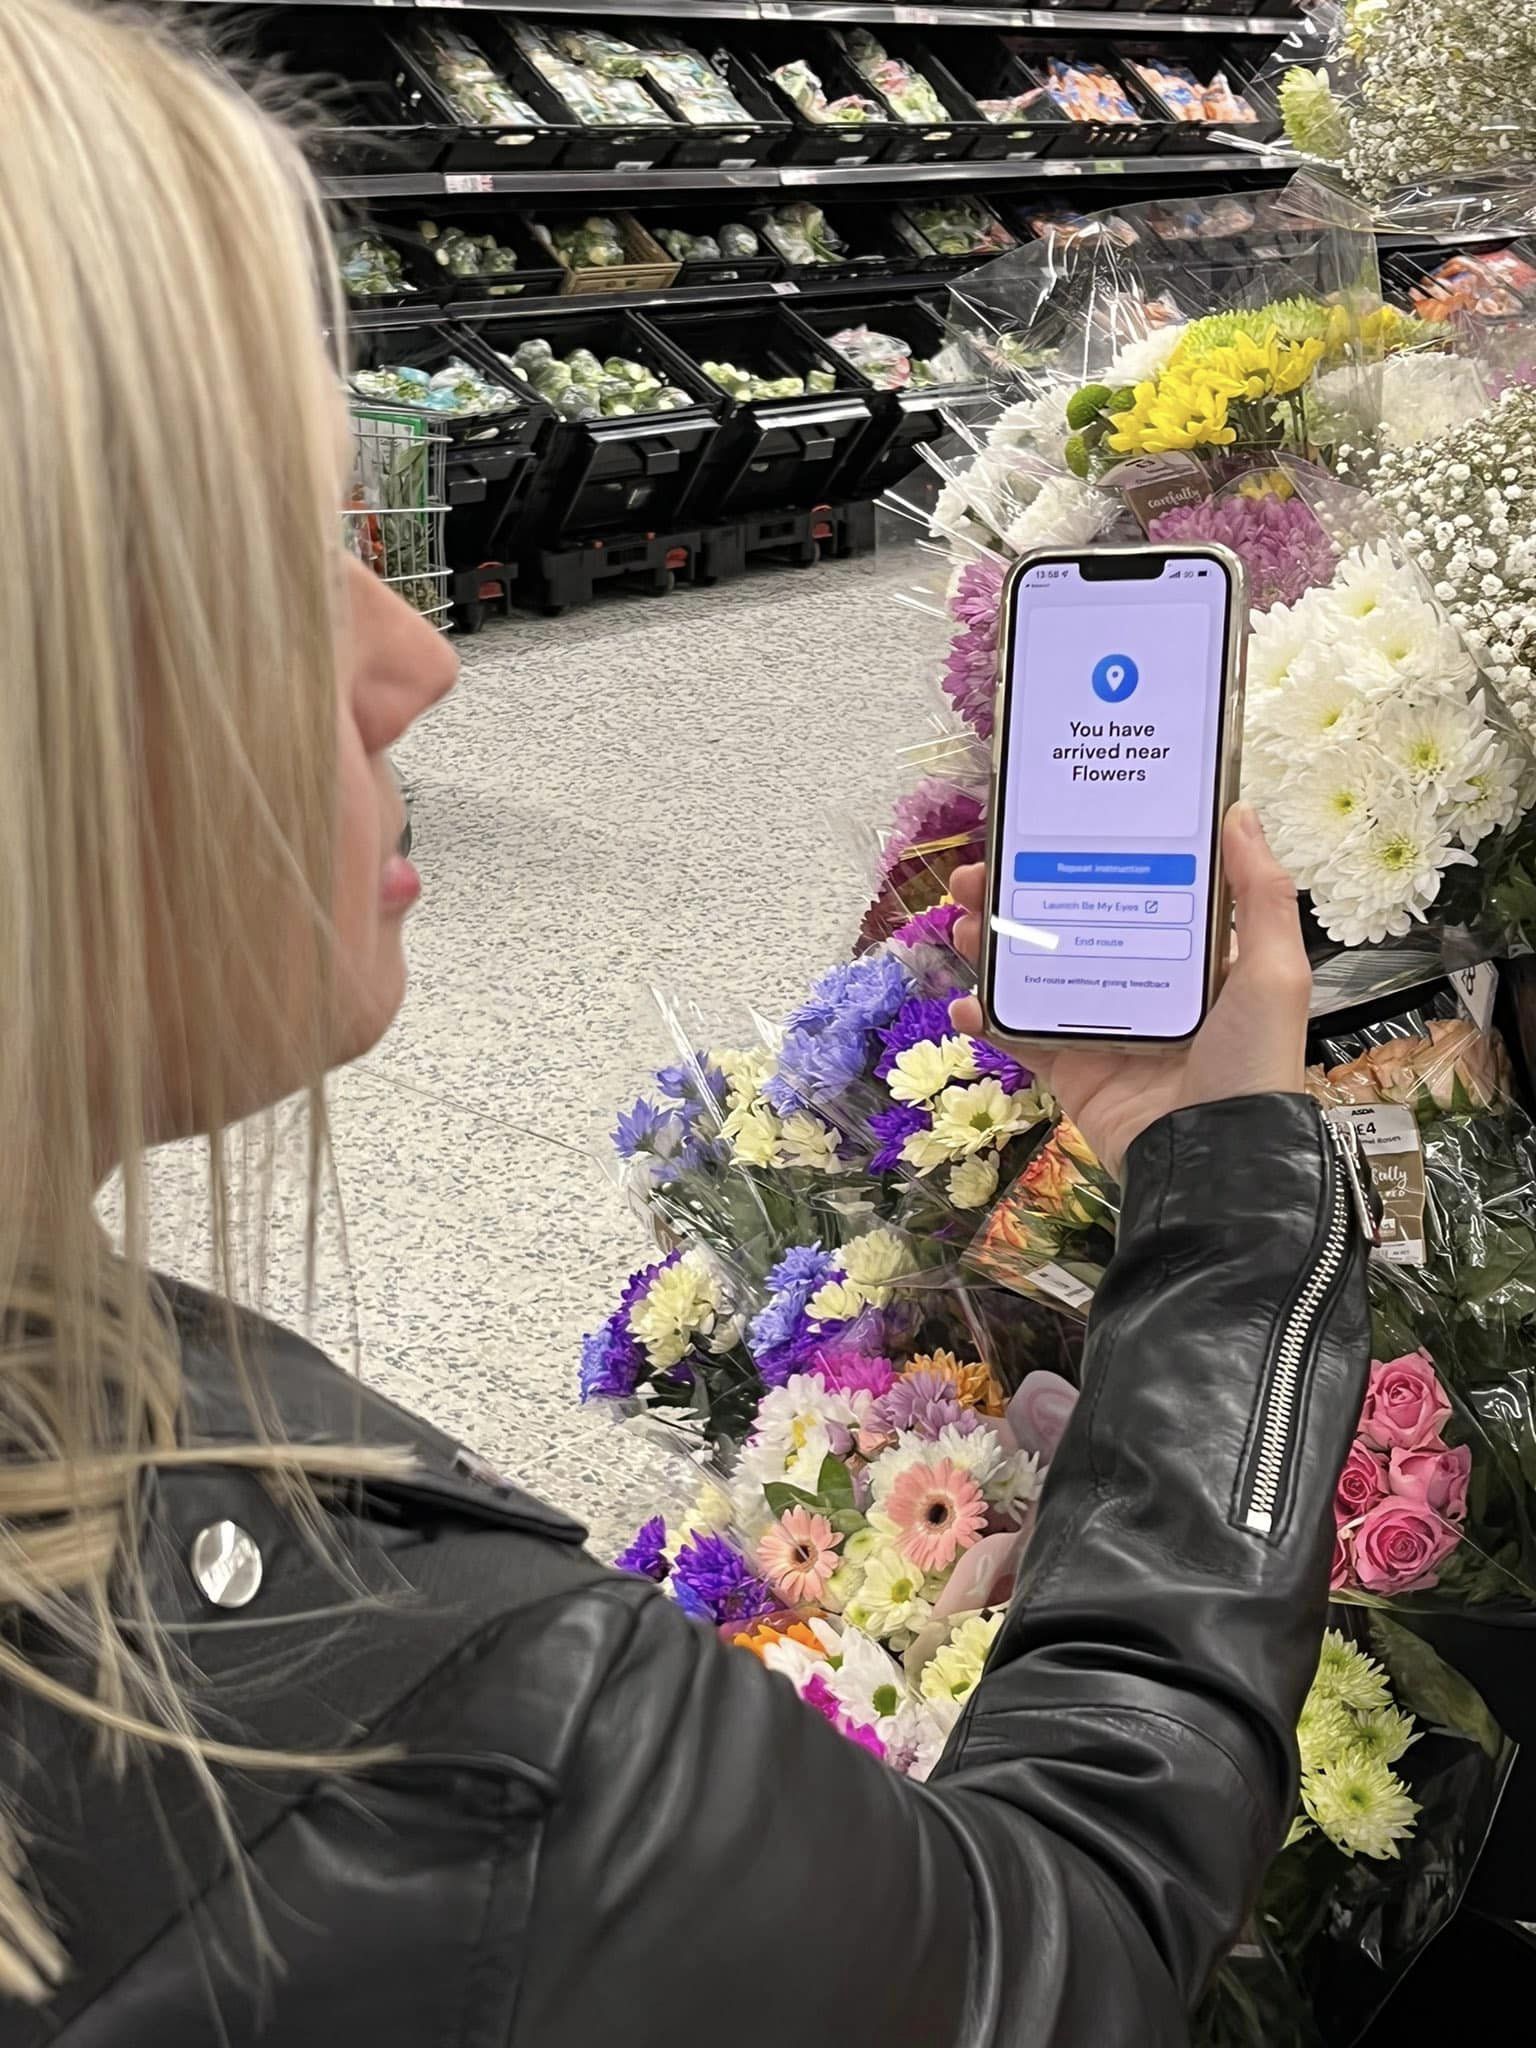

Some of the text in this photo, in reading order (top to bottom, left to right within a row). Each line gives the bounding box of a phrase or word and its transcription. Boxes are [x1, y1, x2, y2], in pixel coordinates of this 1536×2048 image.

[1070, 721, 1156, 737] You have
[1052, 743, 1170, 760] arrived near
[1072, 765, 1147, 782] Flowers
[1043, 900, 1139, 914] Launch Be My Eyes
[1074, 936, 1125, 948] End route
[1024, 975, 1041, 984] End
[1043, 976, 1066, 985] route
[1067, 977, 1100, 987] without
[1129, 979, 1170, 989] feedback
